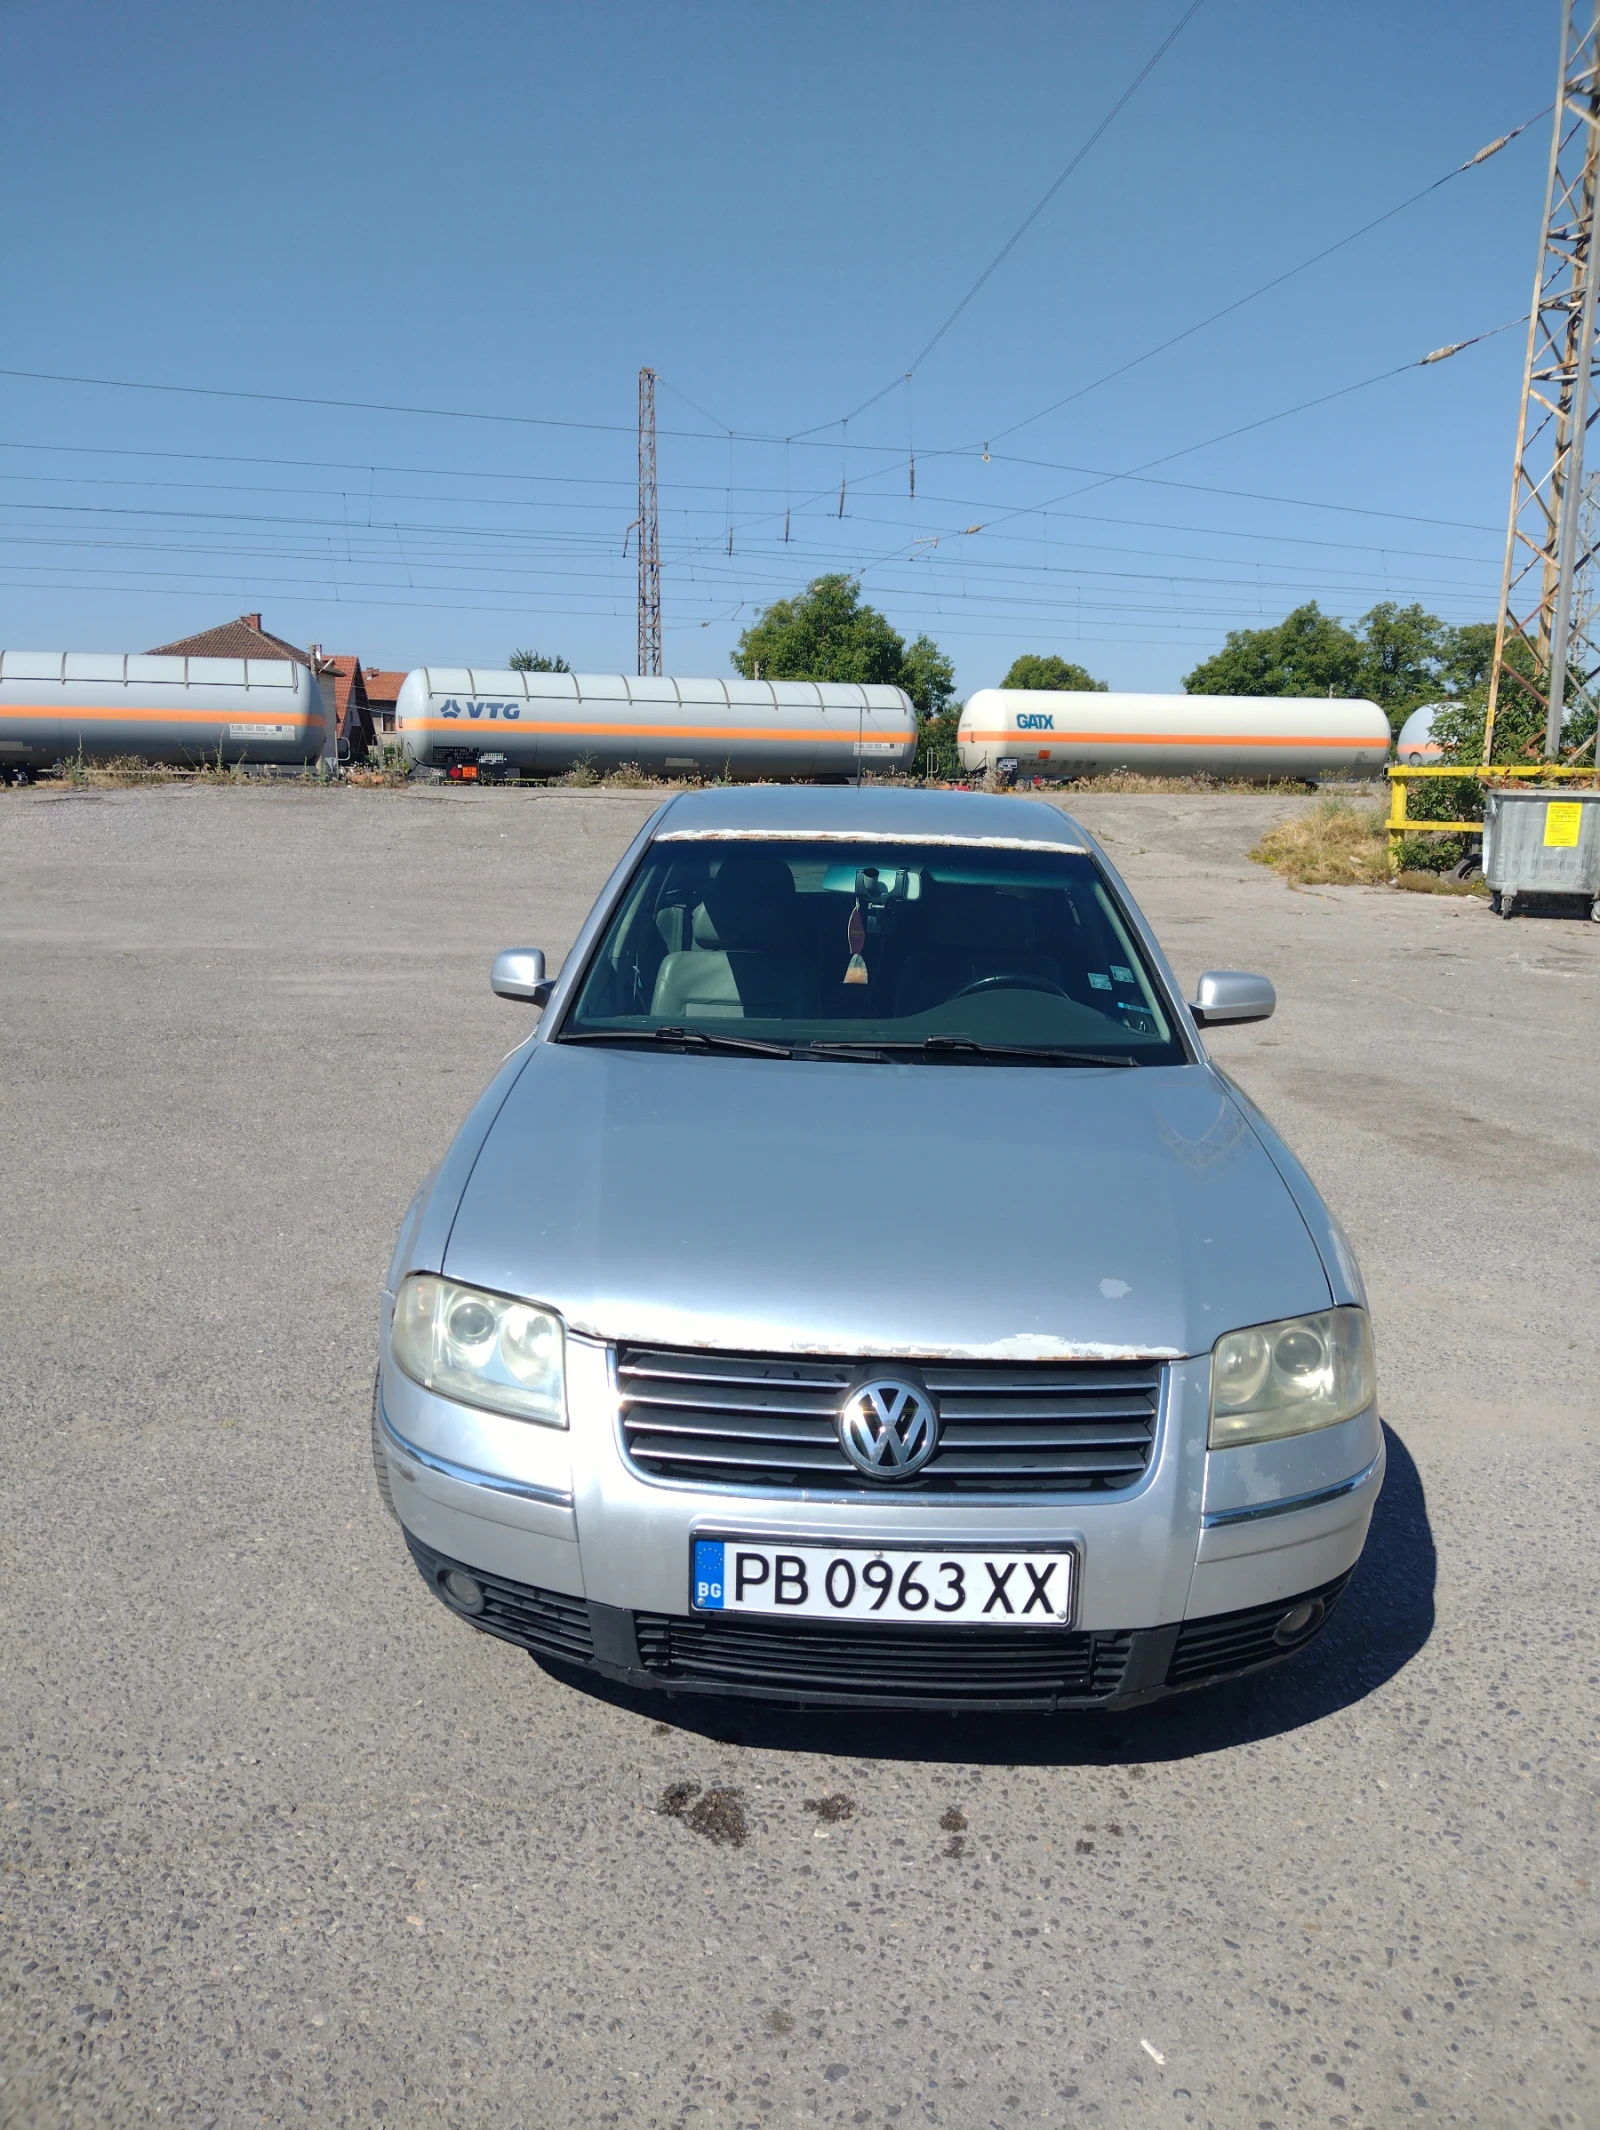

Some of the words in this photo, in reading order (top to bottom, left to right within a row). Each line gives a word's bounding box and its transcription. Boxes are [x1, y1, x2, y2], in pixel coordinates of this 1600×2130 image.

[466, 702, 520, 719] VTG
[1016, 713, 1054, 730] GATX
[697, 1582, 722, 1598] BG
[735, 1551, 809, 1605] PB
[825, 1558, 967, 1613] 0963
[981, 1562, 1058, 1614] XX
